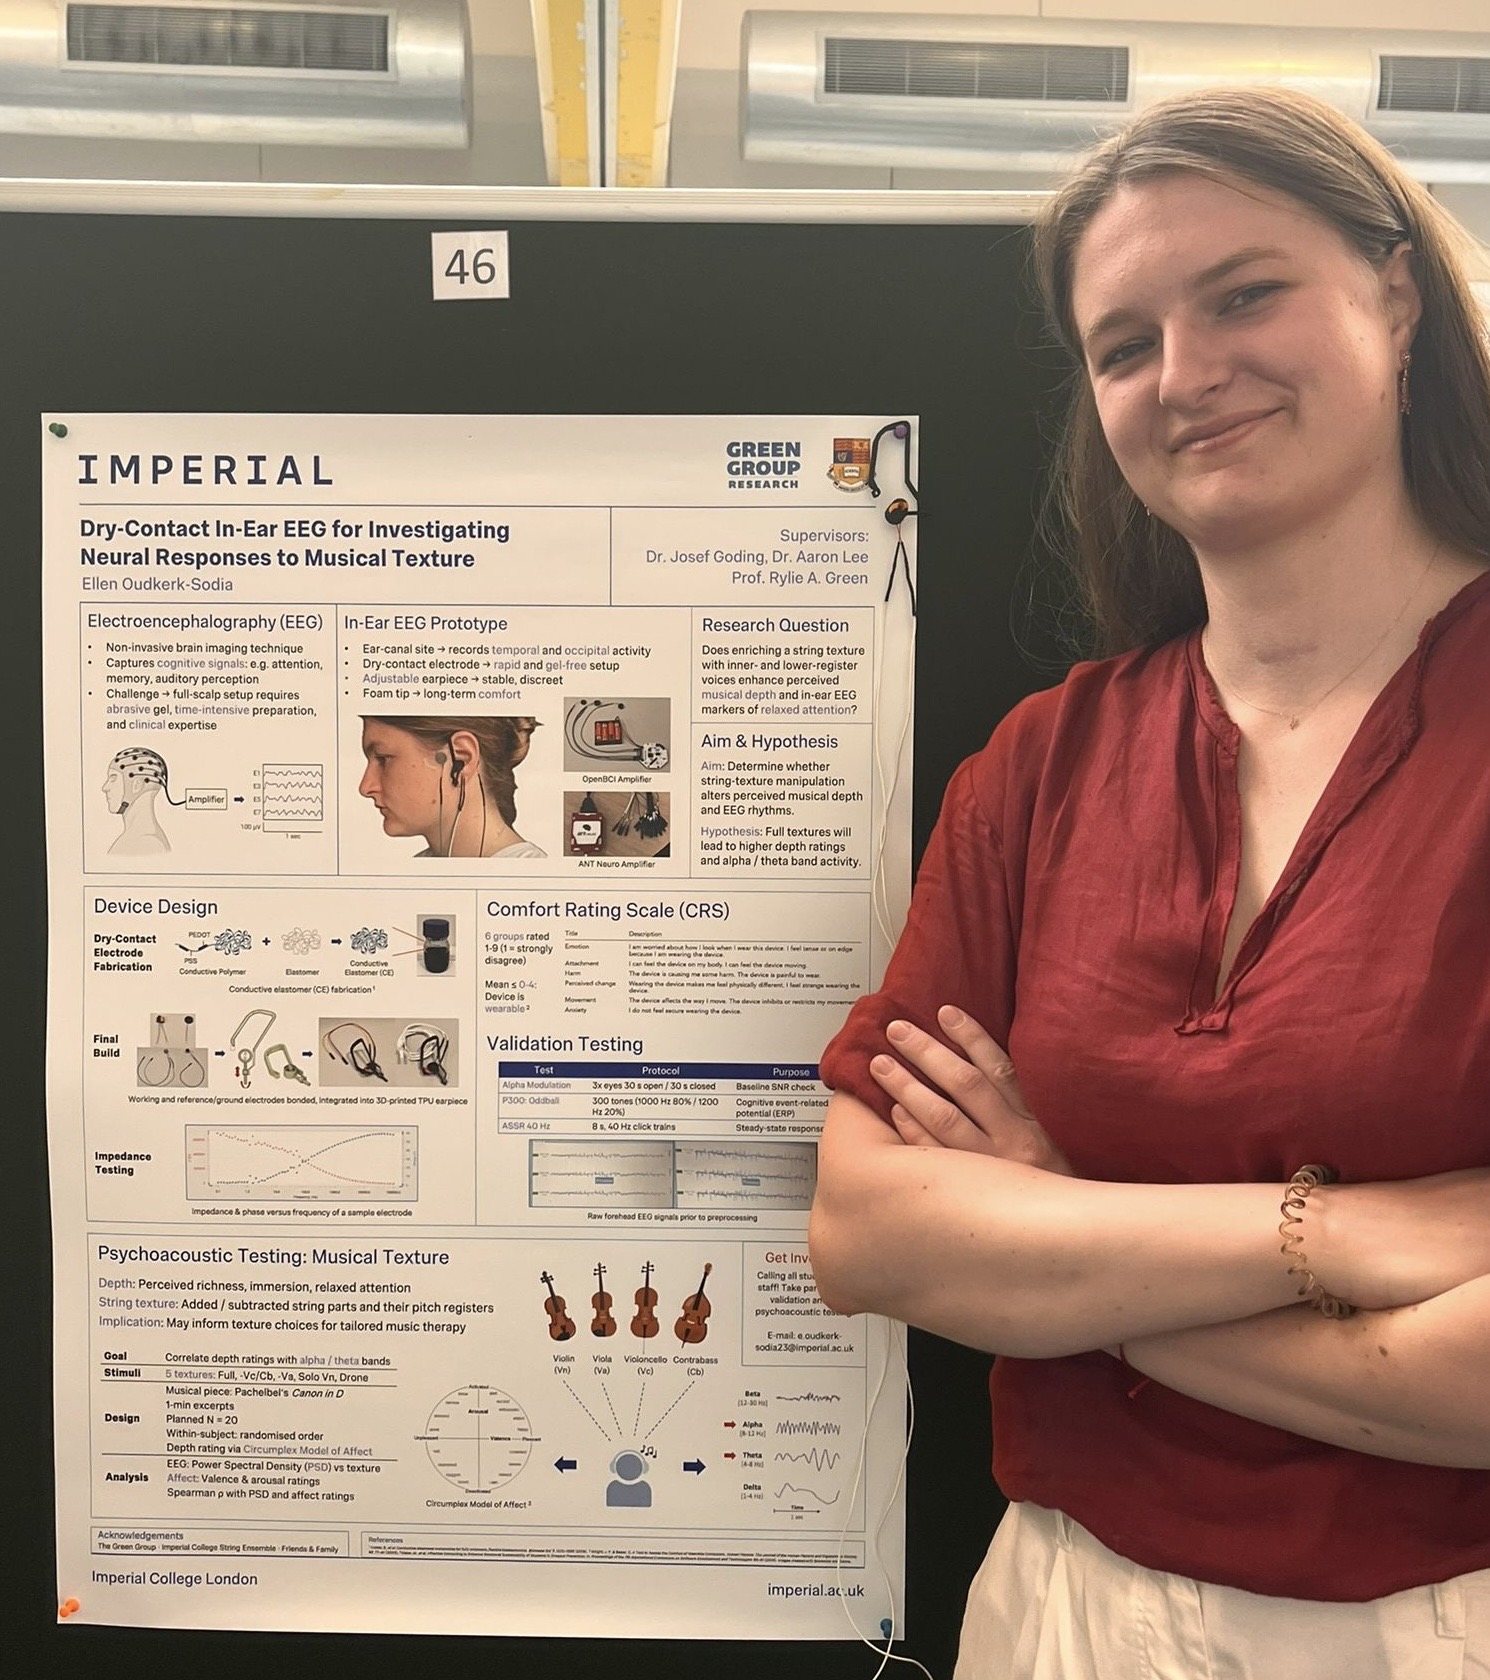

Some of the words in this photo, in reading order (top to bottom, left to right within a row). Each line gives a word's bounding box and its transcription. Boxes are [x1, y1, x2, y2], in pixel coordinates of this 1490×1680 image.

[444, 248, 496, 285] 46
[726, 441, 801, 458] GREEN
[78, 454, 333, 485] IMPERIAL
[726, 460, 801, 476] GROUP
[728, 480, 798, 489] RESEARCH
[81, 519, 210, 541] Dry-Contact
[216, 519, 278, 537] In-Ear
[284, 520, 326, 538] EEG
[332, 519, 363, 538] for
[369, 520, 509, 543] Investigating
[780, 528, 869, 545] Supervisors:
[81, 547, 149, 566] Neural
[156, 548, 271, 570] Responses
[276, 549, 299, 566] to
[305, 548, 386, 567] Musical
[391, 549, 475, 567] Texture
[646, 550, 666, 563] Dr.
[670, 549, 710, 563] Josef
[713, 549, 768, 566] Goding,
[772, 550, 792, 563] Dr.
[796, 550, 838, 563] Aaron
[843, 550, 869, 563] Lee
[82, 576, 118, 591] Ellen
[122, 576, 233, 591] Oudkerk-Sodia
[732, 570, 765, 584] Prof.
[769, 570, 804, 587] Rylie
[807, 571, 821, 584] A.
[825, 571, 868, 585] Green
[88, 613, 277, 633] Electroencephalography
[280, 613, 323, 631] (EEG)
[345, 615, 390, 630] In-Ear
[394, 615, 426, 630] EEG
[431, 616, 508, 634] Prototype
[703, 617, 775, 632] Research
[779, 618, 849, 633] Question
[106, 642, 174, 653] Non-invasive
[176, 642, 203, 653] brain
[205, 642, 248, 656] imaging
[250, 643, 304, 656] technique
[363, 643, 413, 654] Ear-canal
[415, 644, 435, 655] site
[448, 644, 490, 655] records
[492, 645, 540, 657] temporal
[542, 645, 562, 656] and
[564, 645, 610, 657] occipital
[612, 645, 651, 658] activity
[702, 645, 730, 655] Does
[732, 645, 782, 658] enriching
[784, 647, 790, 655] a
[793, 645, 824, 658] string
[826, 646, 865, 656] texture
[106, 657, 155, 670] Captures
[157, 658, 206, 670] cognitive
[208, 658, 248, 671] signals:
[250, 660, 269, 671] e.g.
[271, 659, 323, 671] attention,
[701, 659, 725, 670] with
[727, 659, 758, 670] inner-
[760, 660, 780, 670] and
[783, 660, 858, 673] lower-register
[701, 733, 731, 748] Aim
[736, 734, 747, 748] &
[752, 733, 838, 752] Hypothesis
[701, 761, 725, 771] Aim:
[727, 760, 784, 772] Determine
[786, 762, 831, 772] whether
[582, 775, 616, 784] OpenBCI
[617, 775, 652, 785] Amplifier
[701, 776, 774, 788] string-texture
[776, 776, 845, 789] manipulation
[188, 795, 225, 804] Amplifier
[578, 860, 595, 868] ANT
[596, 860, 620, 868] Neuro
[620, 860, 656, 869] Amplifier
[95, 898, 153, 914] Device
[158, 899, 218, 918] Design
[487, 901, 560, 917] Comfort
[565, 902, 621, 922] Rating
[626, 902, 674, 918] Scale
[679, 901, 730, 921] (CRS)
[94, 934, 157, 946] Dry-Contact
[485, 931, 491, 941] 6
[493, 933, 524, 944] groups
[526, 932, 550, 941] rated
[94, 947, 144, 958] Electrode
[485, 943, 499, 953] 1-9
[500, 943, 507, 954] (1
[517, 944, 554, 955] strongly
[94, 961, 152, 972] Fabrication
[484, 955, 527, 967] disagree)
[219, 968, 246, 977] Polymer
[93, 1034, 119, 1044] Final
[486, 1035, 573, 1052] Validation
[578, 1036, 643, 1056] Testing
[93, 1048, 120, 1058] Build
[534, 1065, 554, 1075] Test
[642, 1066, 680, 1075] Protocol
[773, 1067, 810, 1080] Purpose
[502, 1081, 526, 1091] Alpha
[527, 1081, 571, 1090] Modulation
[736, 1083, 770, 1092] Baseline
[771, 1083, 789, 1092] SNR
[790, 1083, 816, 1092] check
[502, 1122, 525, 1131] ASSR
[526, 1122, 538, 1131] 40
[539, 1122, 550, 1131] Hz
[95, 1151, 152, 1163] Impedance
[95, 1165, 134, 1177] Testing
[99, 1245, 233, 1264] Psychoacoustic
[238, 1248, 307, 1268] Testing:
[312, 1248, 377, 1265] Musical
[383, 1249, 449, 1265] Texture
[99, 1277, 136, 1291] Depth:
[138, 1278, 194, 1291] Perceived
[196, 1279, 247, 1293] richness,
[250, 1280, 313, 1294] immersion,
[315, 1281, 357, 1293] relaxed
[359, 1282, 411, 1293] attention
[767, 1331, 796, 1340] E-mail:
[103, 1352, 127, 1361] Goal
[552, 1354, 575, 1363] Violin
[592, 1354, 612, 1363] Viola
[623, 1355, 668, 1364] Violoncello
[672, 1355, 719, 1365] Contrabass
[104, 1368, 141, 1377] Stimuli
[554, 1365, 571, 1375] (Vn)
[593, 1366, 611, 1376] (Va)
[637, 1366, 654, 1376] (Vc)
[687, 1367, 705, 1377] (Cb)
[166, 1386, 202, 1396] Musical
[203, 1386, 232, 1397] piece:
[292, 1388, 323, 1398] Canon
[324, 1389, 334, 1398] in
[335, 1389, 344, 1399] D
[744, 1390, 761, 1398] Beta
[104, 1413, 140, 1425] Design
[742, 1421, 763, 1430] Alpha
[742, 1451, 763, 1459] Theta
[105, 1472, 149, 1484] Analysis
[743, 1483, 762, 1491] Delta
[97, 1530, 185, 1542] Acknowledgements
[92, 1570, 146, 1586] Imperial
[149, 1571, 202, 1588] College
[206, 1572, 258, 1585] London
[768, 1582, 865, 1598] imperial.ac.uk
